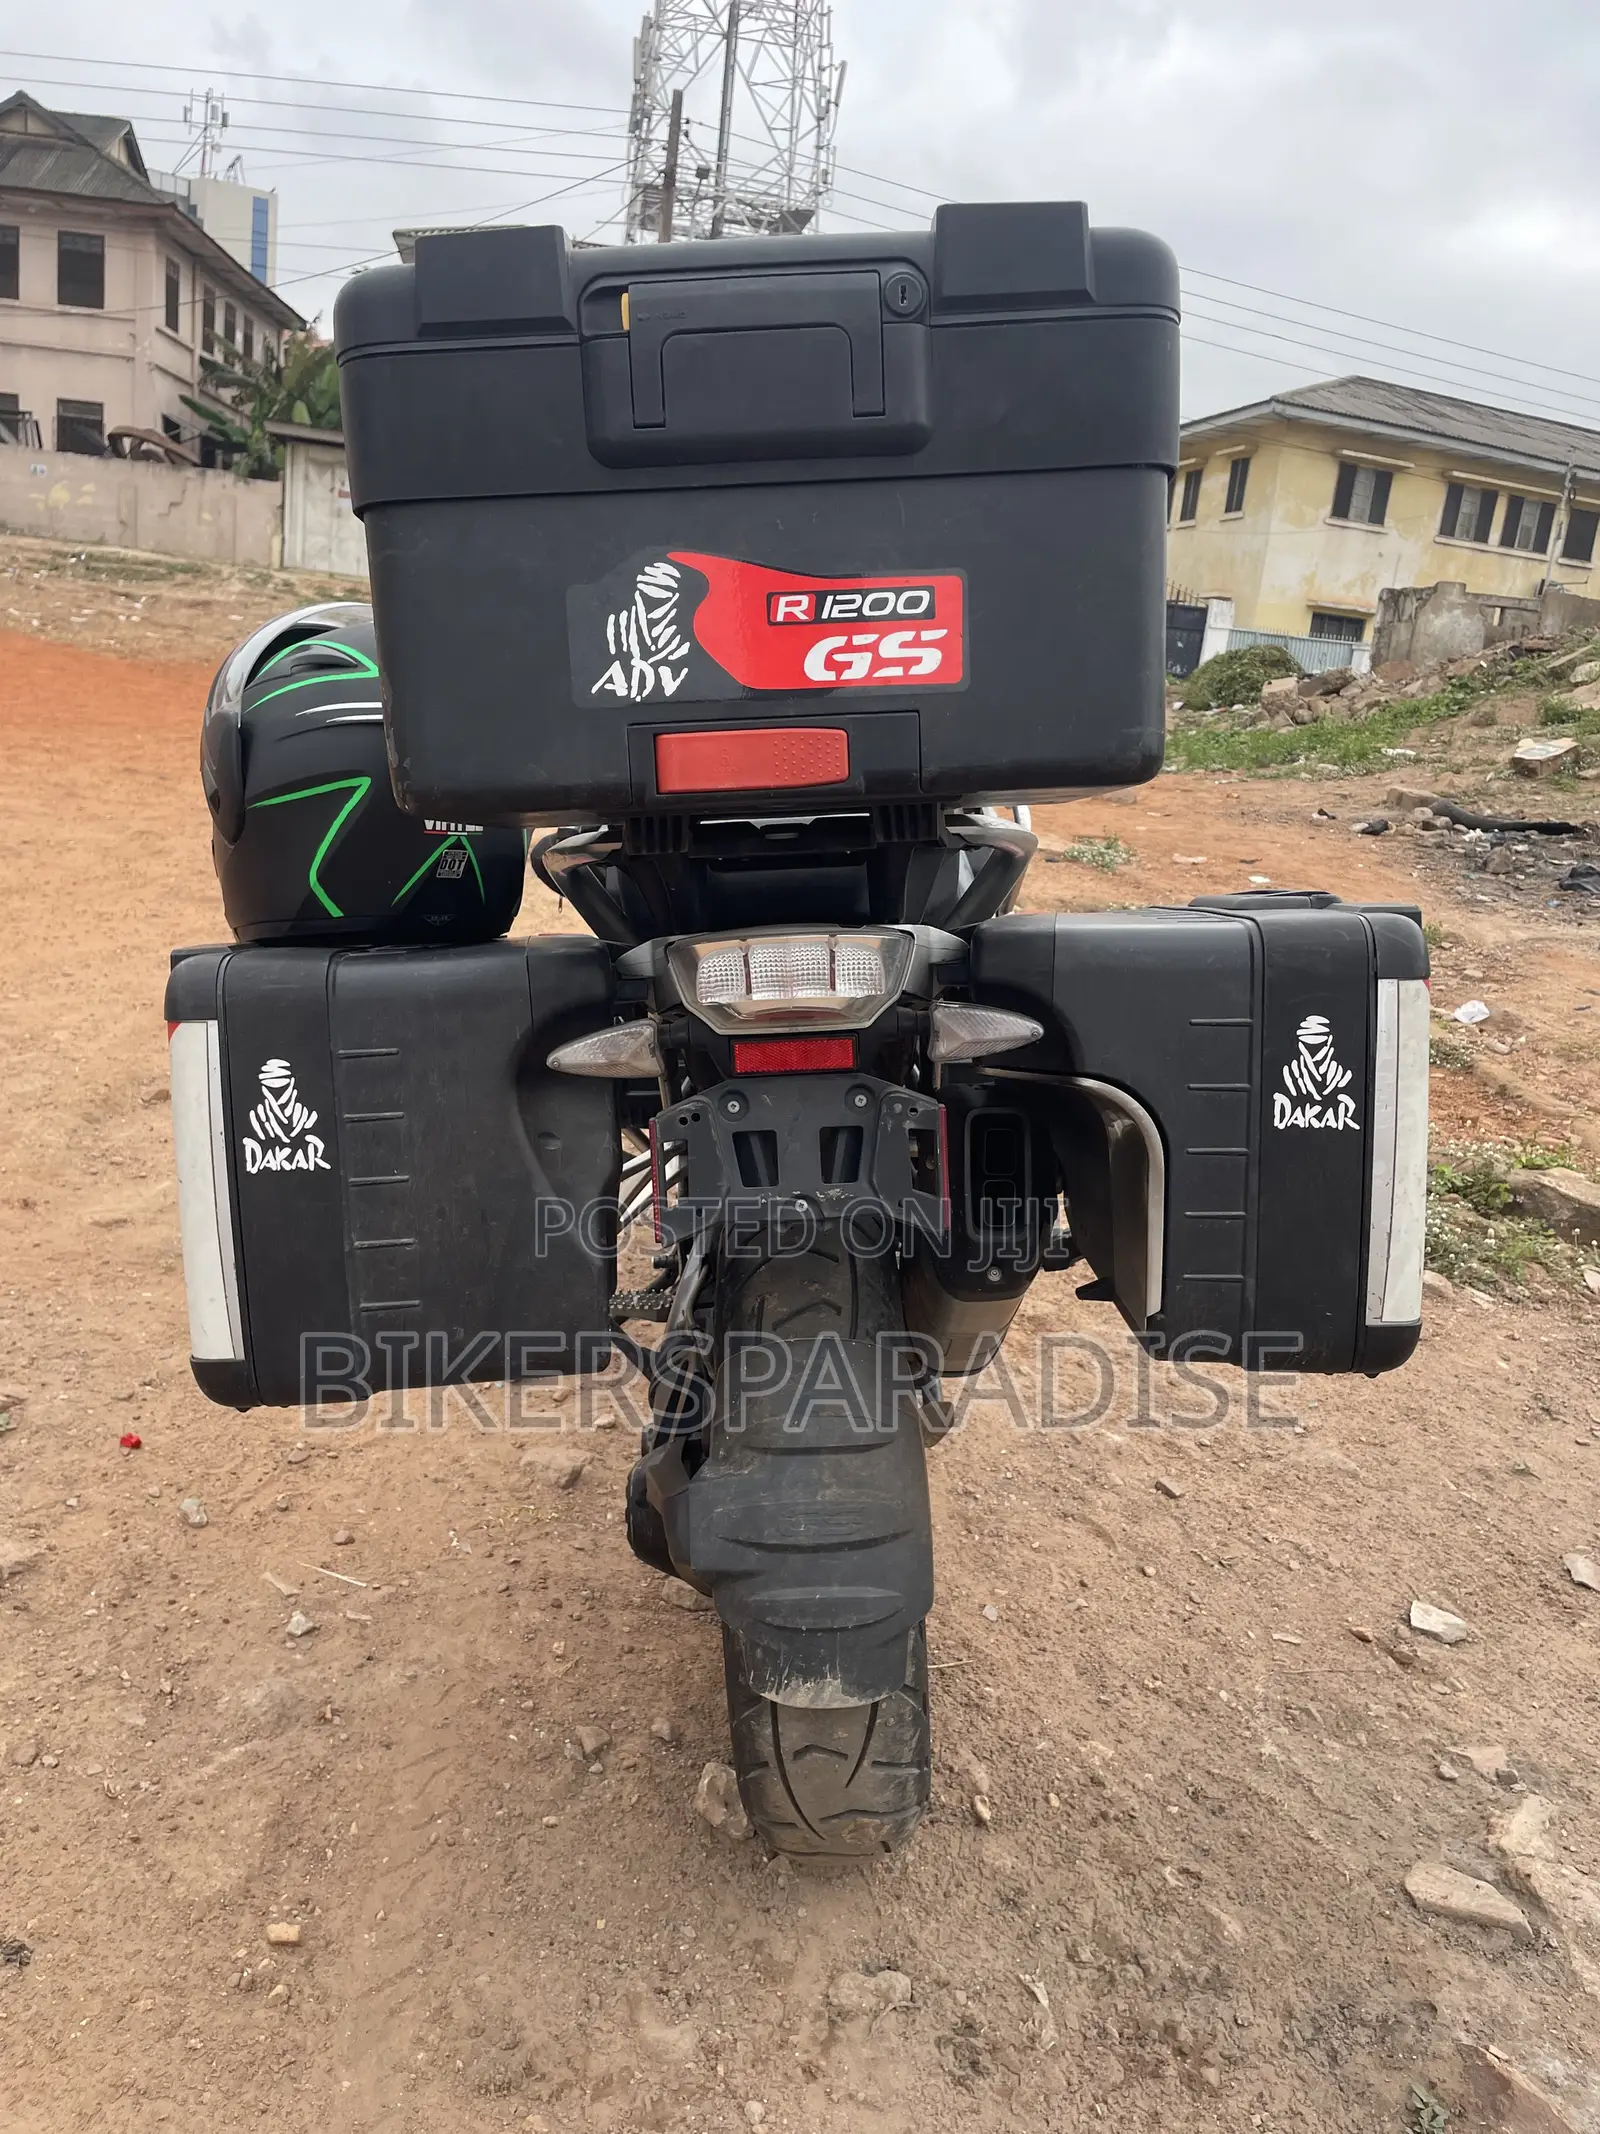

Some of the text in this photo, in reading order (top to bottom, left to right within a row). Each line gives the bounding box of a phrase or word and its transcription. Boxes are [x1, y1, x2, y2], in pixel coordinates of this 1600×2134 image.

[775, 588, 933, 622] R 1200
[803, 629, 948, 681] GS
[591, 660, 689, 702] ADV
[1272, 1092, 1361, 1131] DAKAR
[242, 1135, 332, 1174] DAKAR
